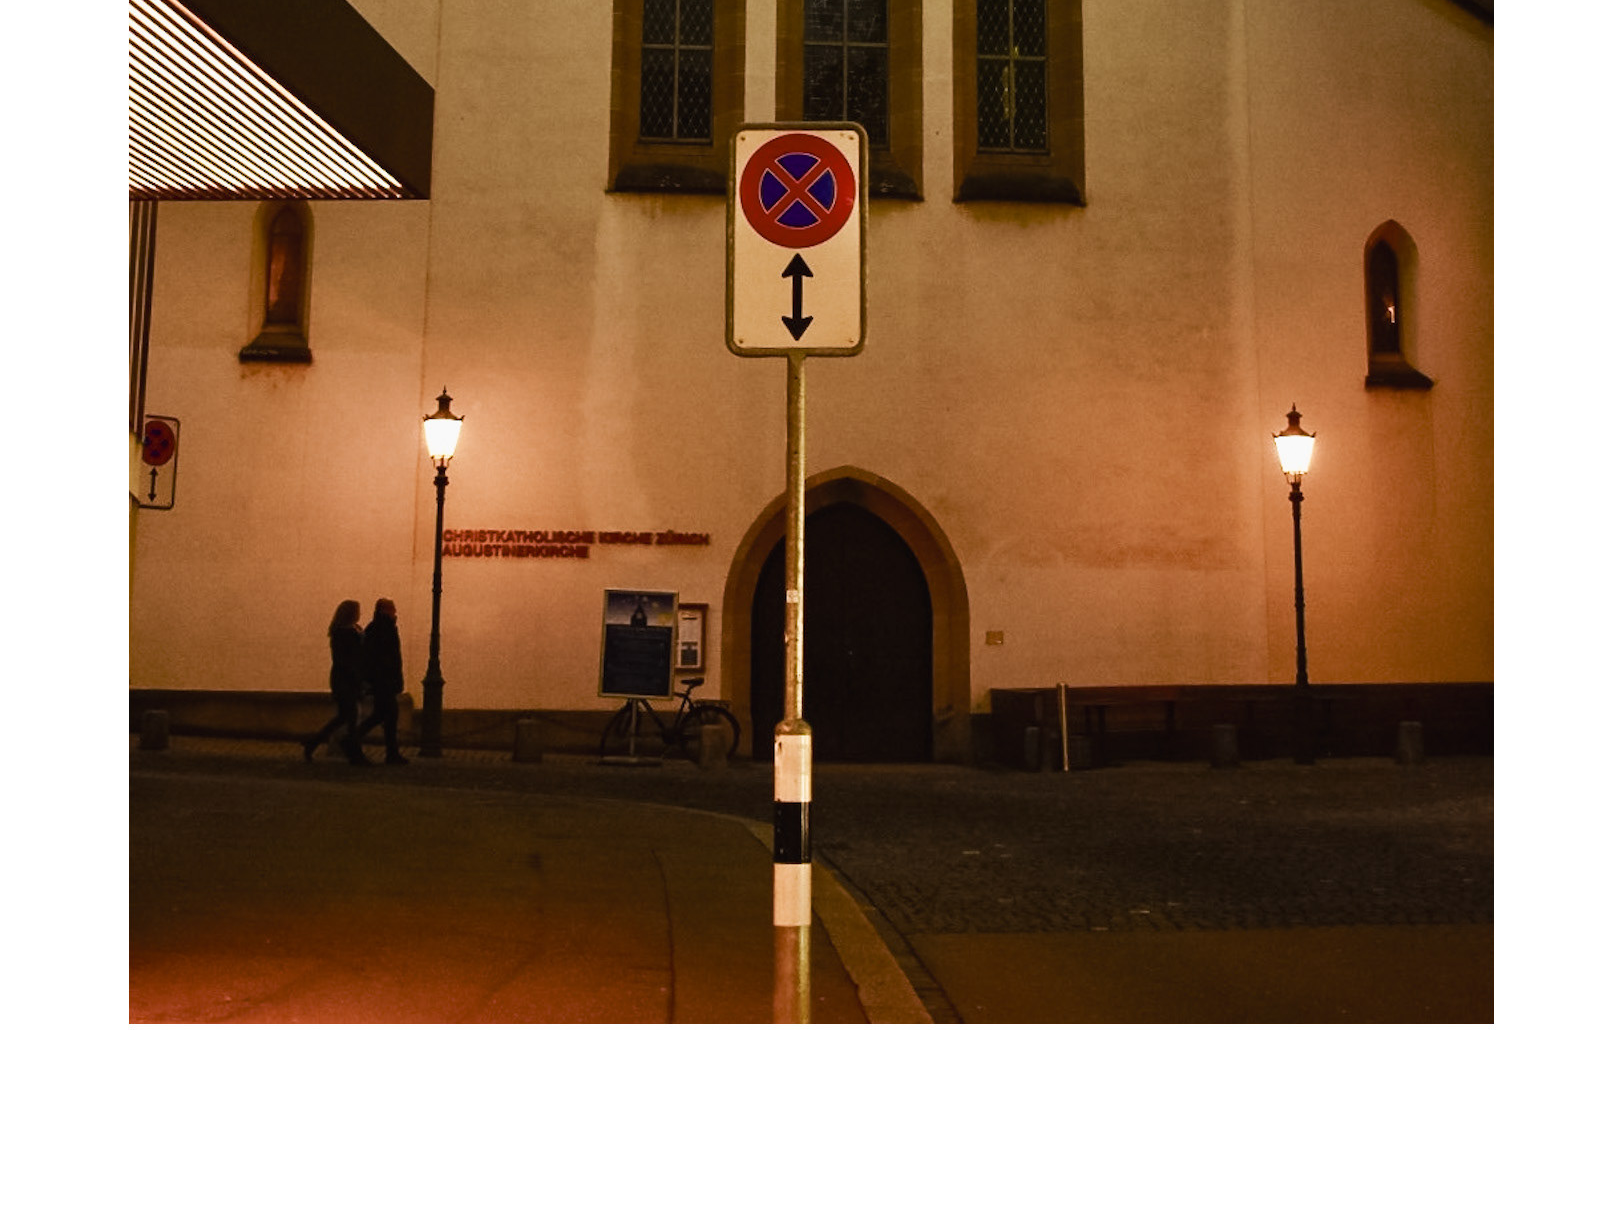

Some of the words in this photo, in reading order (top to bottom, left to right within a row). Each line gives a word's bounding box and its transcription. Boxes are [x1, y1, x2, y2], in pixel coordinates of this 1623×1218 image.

[442, 529, 595, 544] CHRISTKATHOLISCHE
[598, 531, 653, 545] KIRCHE
[655, 529, 710, 546] ZÜRICH
[441, 544, 590, 558] AUGUSTINERKIRCHE
